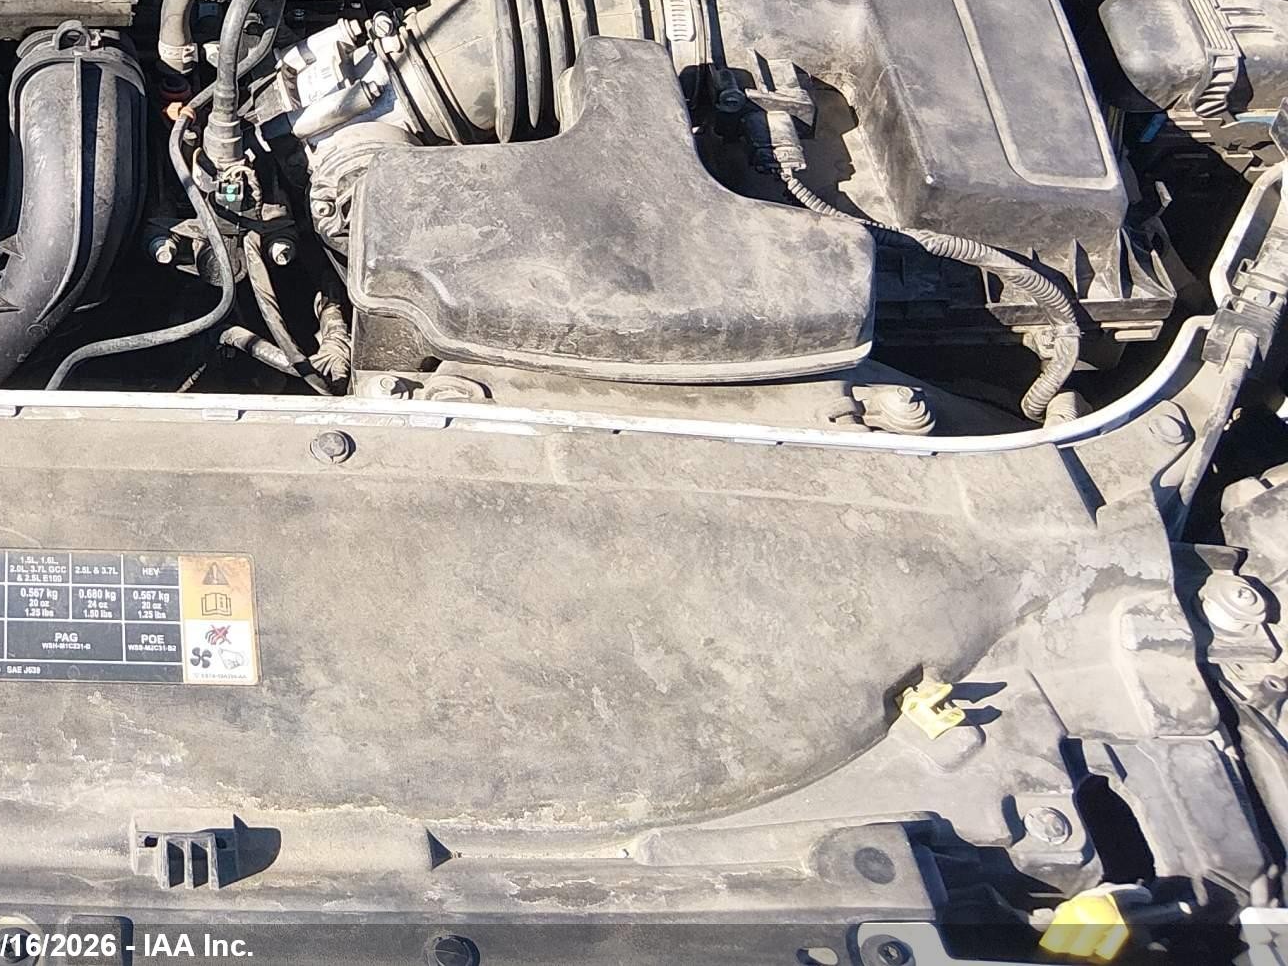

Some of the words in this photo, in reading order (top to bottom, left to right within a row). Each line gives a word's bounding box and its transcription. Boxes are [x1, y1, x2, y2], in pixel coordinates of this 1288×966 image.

[93, 566, 100, 574] &
[142, 567, 160, 576] HEV
[46, 588, 58, 600] kg
[105, 589, 116, 601] kg
[158, 591, 170, 603] kg
[29, 599, 38, 607] 20
[87, 600, 97, 608] 24
[25, 608, 41, 617] 1.25
[42, 608, 54, 617] lbs
[100, 609, 113, 618] lbs
[138, 610, 154, 619] 1.25
[154, 610, 166, 619] lbs
[54, 632, 79, 642] PAG
[141, 634, 165, 644] POE
[6, 666, 22, 674] SAE
